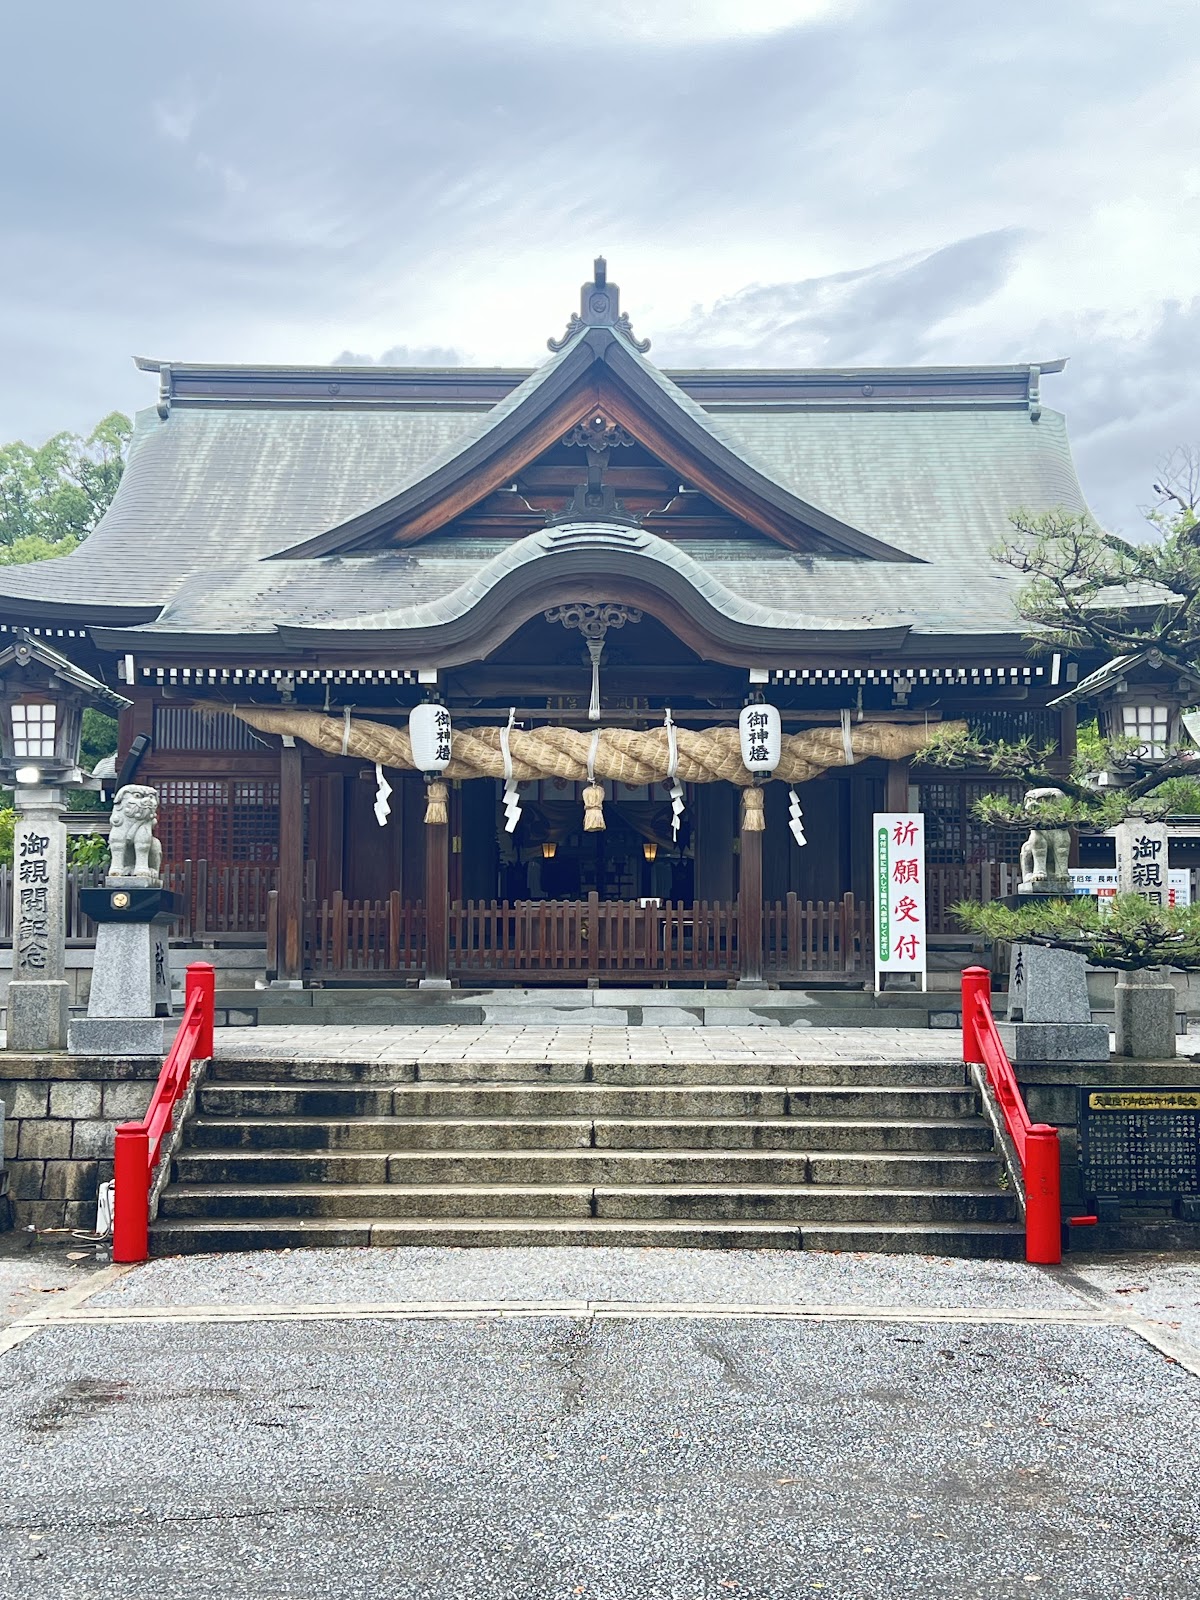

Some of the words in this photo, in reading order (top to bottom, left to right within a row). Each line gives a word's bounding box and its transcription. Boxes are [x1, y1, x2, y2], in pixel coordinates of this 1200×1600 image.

[435, 711, 451, 761] 御神燈
[747, 711, 770, 762] 御神燈
[892, 820, 921, 961] 祈願受付
